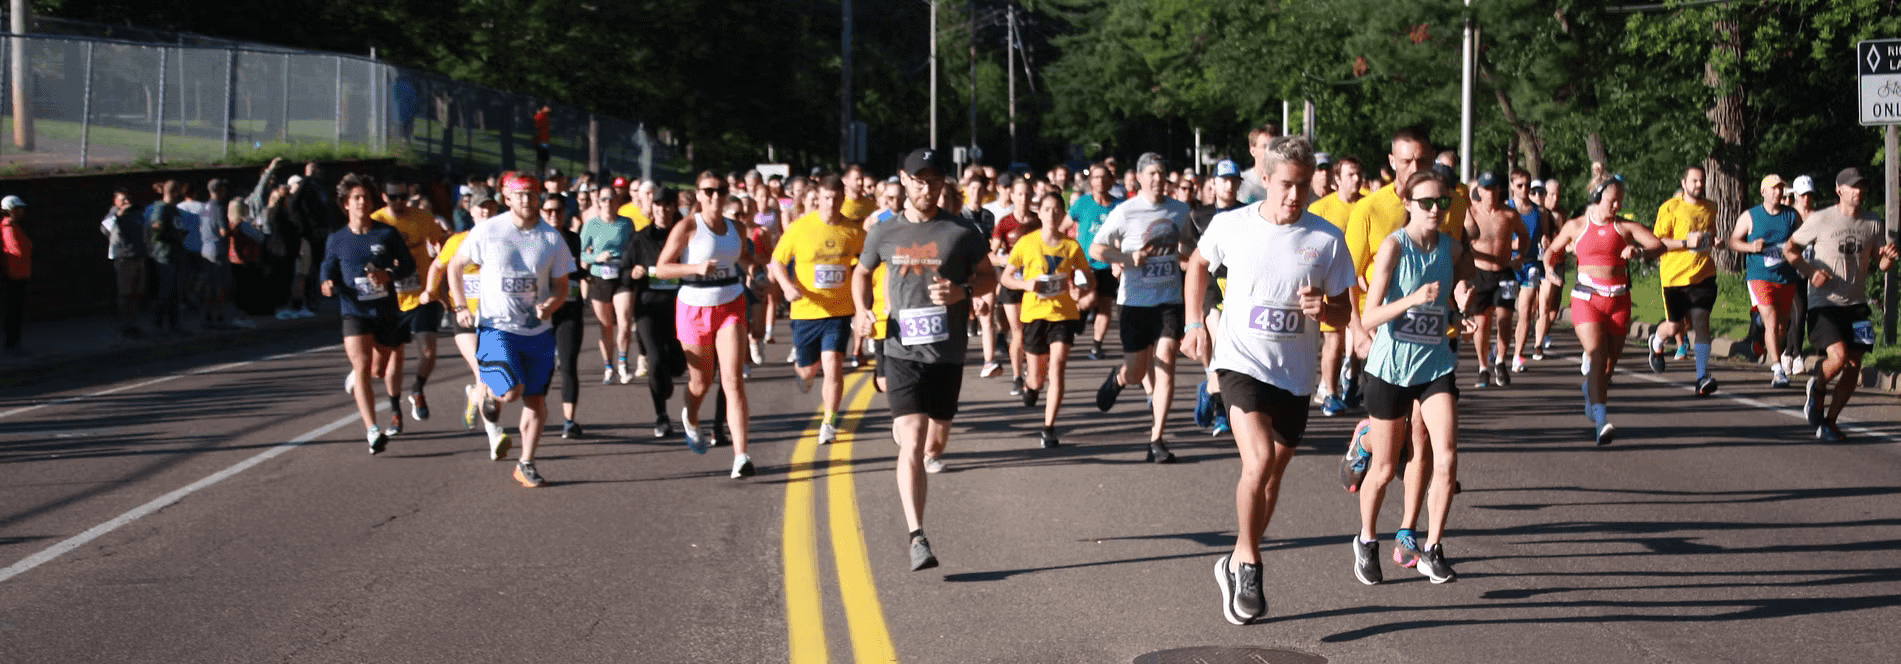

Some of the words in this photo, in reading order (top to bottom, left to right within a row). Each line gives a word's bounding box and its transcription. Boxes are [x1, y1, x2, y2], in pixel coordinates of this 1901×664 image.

[817, 270, 843, 283] 340
[1146, 262, 1173, 277] 279
[503, 278, 534, 292] 385
[905, 316, 943, 337] 338
[1254, 308, 1299, 332] 430
[1400, 312, 1439, 336] 262
